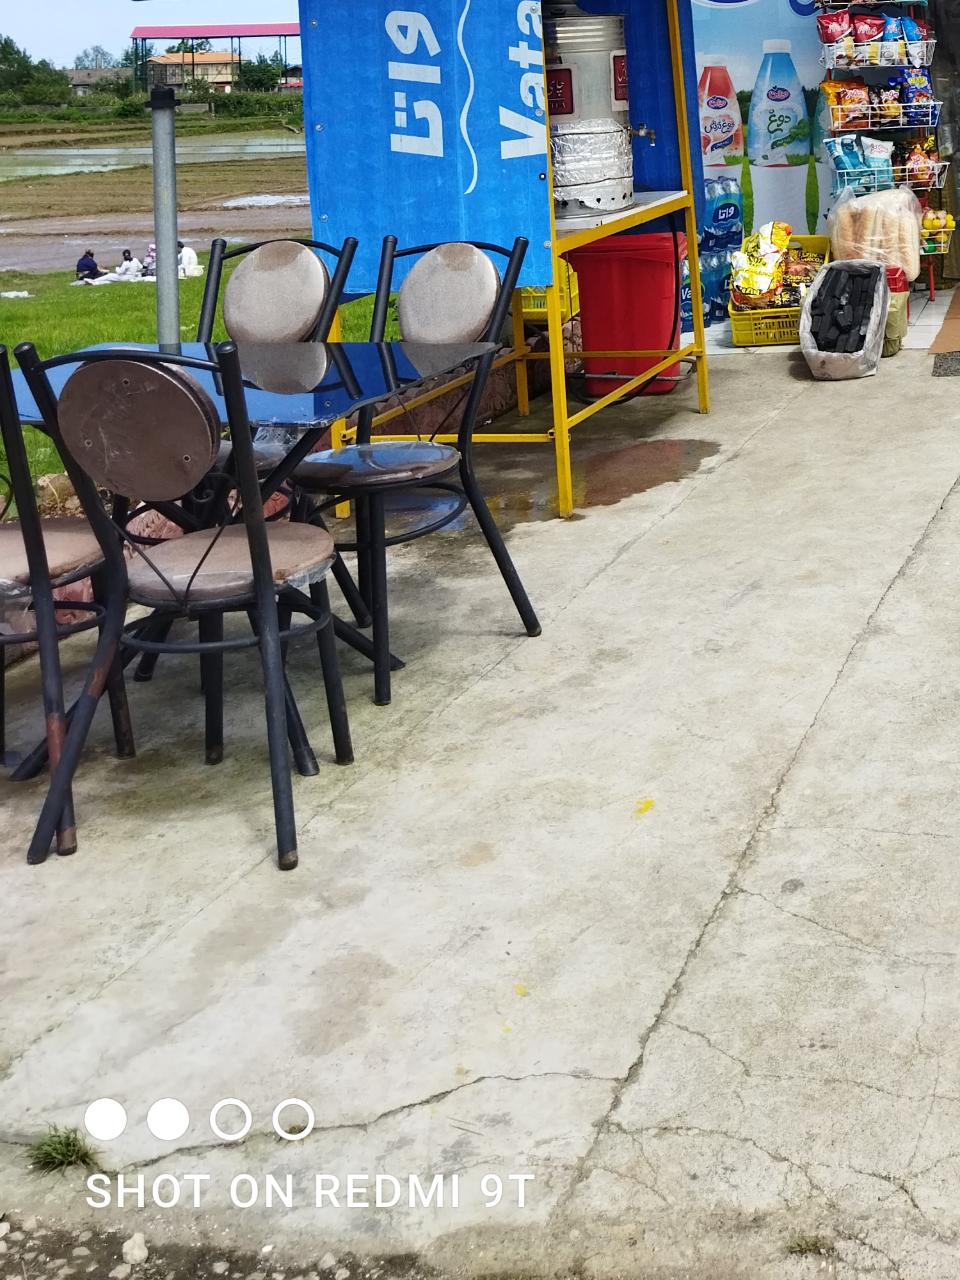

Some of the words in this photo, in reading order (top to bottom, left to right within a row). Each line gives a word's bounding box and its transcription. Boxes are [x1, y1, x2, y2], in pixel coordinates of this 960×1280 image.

[384, 10, 444, 157] واتا
[498, 0, 548, 160] Vata
[767, 109, 792, 134] دوغ
[718, 206, 735, 220] واتا
